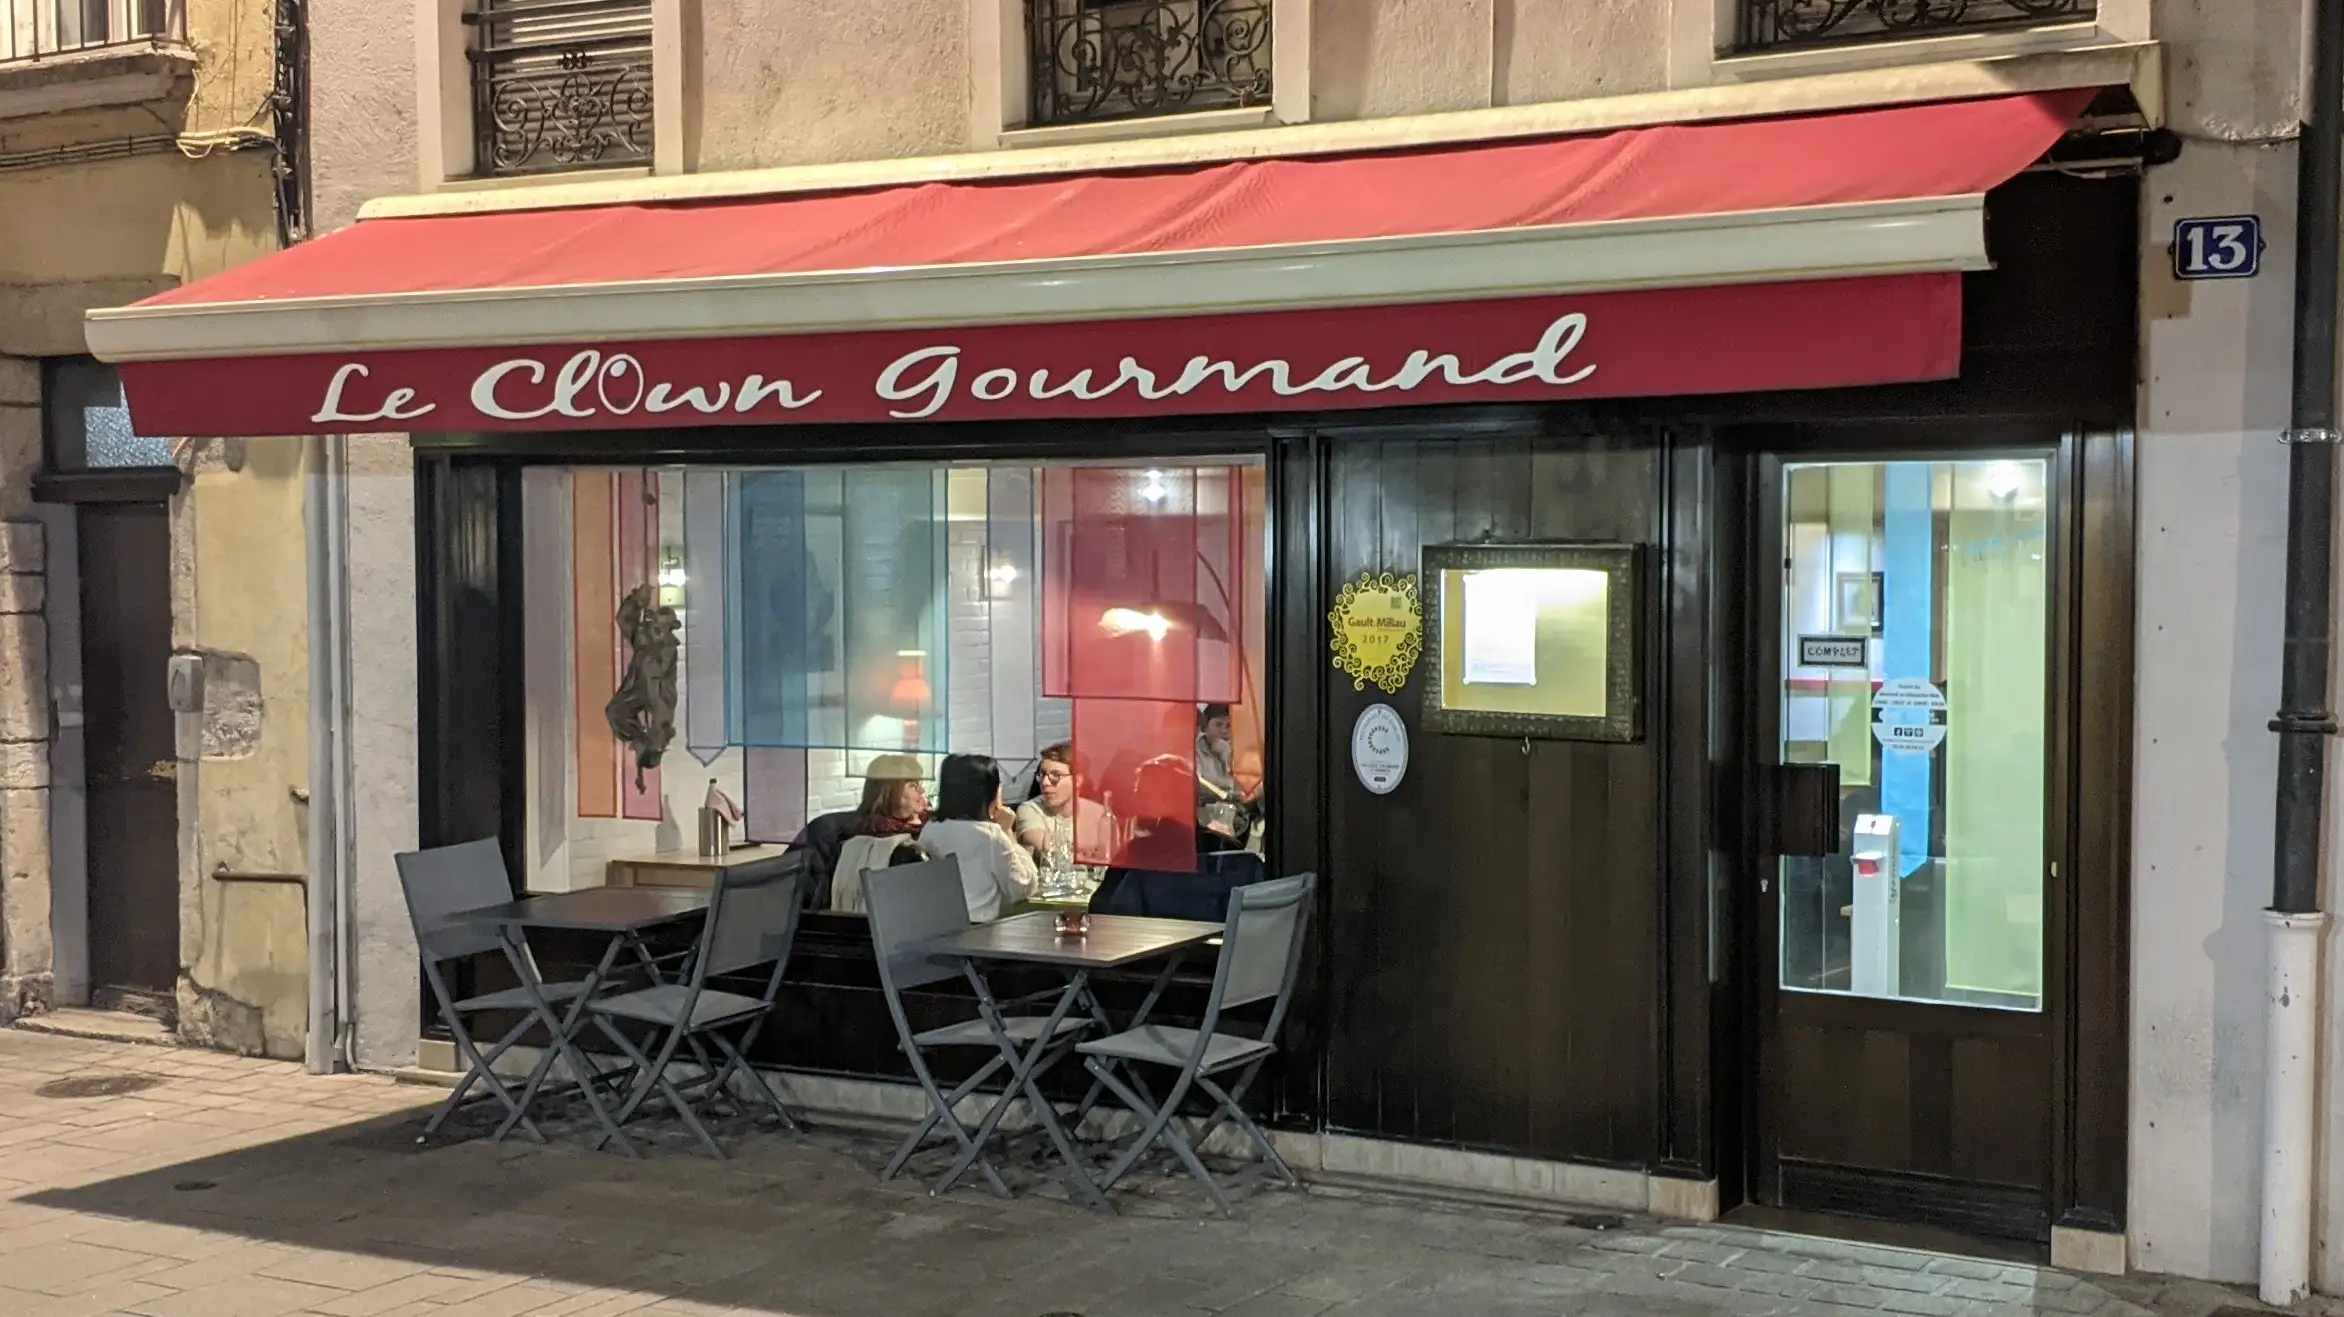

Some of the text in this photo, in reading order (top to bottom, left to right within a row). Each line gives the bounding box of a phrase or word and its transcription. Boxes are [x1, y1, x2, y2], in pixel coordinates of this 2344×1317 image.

[2185, 225, 2247, 271] 13
[311, 362, 436, 423] Le
[875, 313, 1597, 419] Gourmand
[1347, 616, 1374, 628] Gault
[1361, 634, 1390, 645] 2017
[1807, 645, 1861, 658] COMPLET
